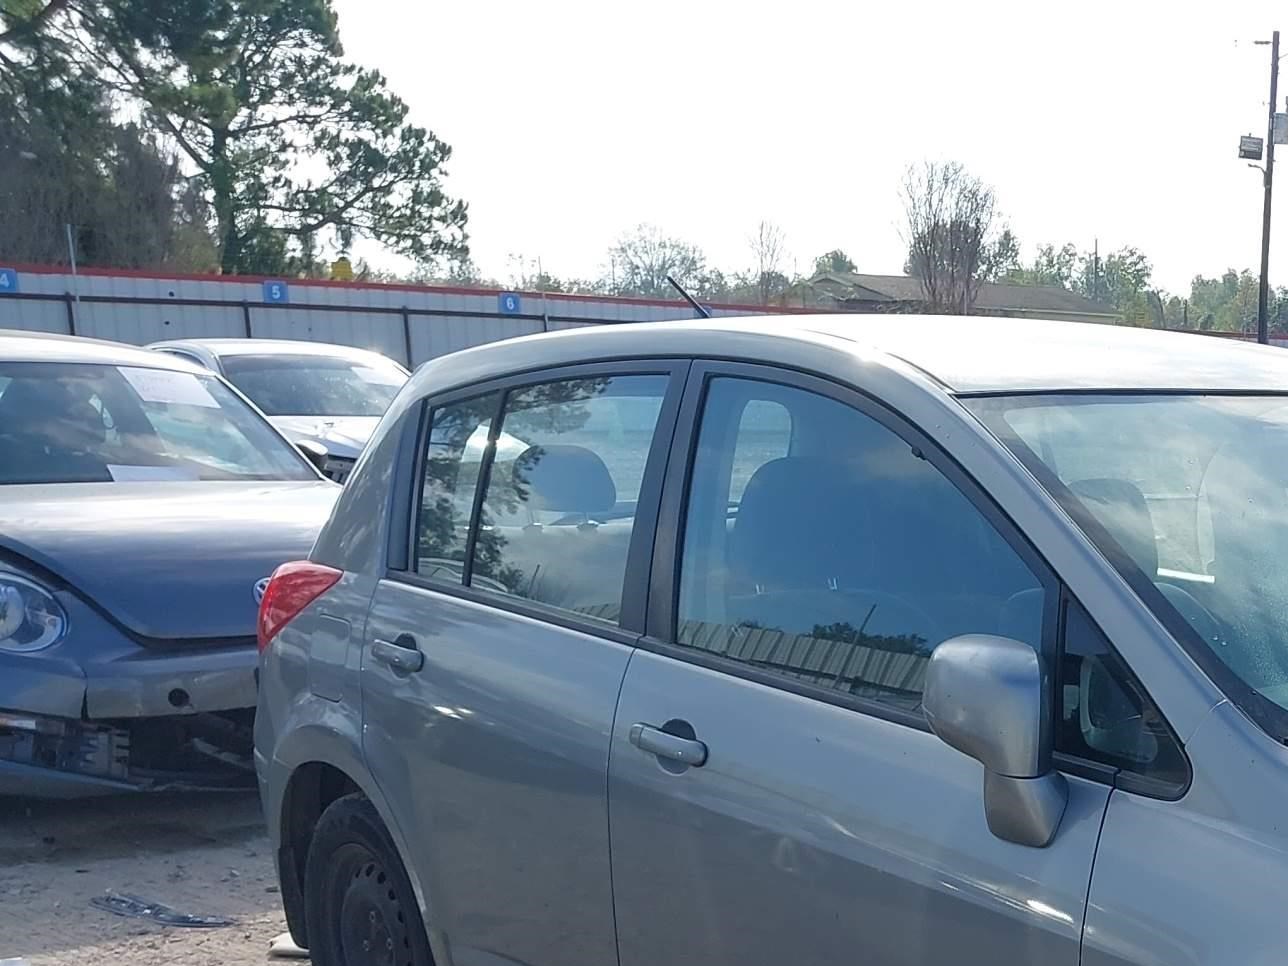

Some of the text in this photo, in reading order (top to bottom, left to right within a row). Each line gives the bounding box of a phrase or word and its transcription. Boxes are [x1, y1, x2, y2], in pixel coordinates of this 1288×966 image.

[0, 273, 9, 288] 4
[271, 284, 281, 299] 5
[506, 296, 515, 310] 6
